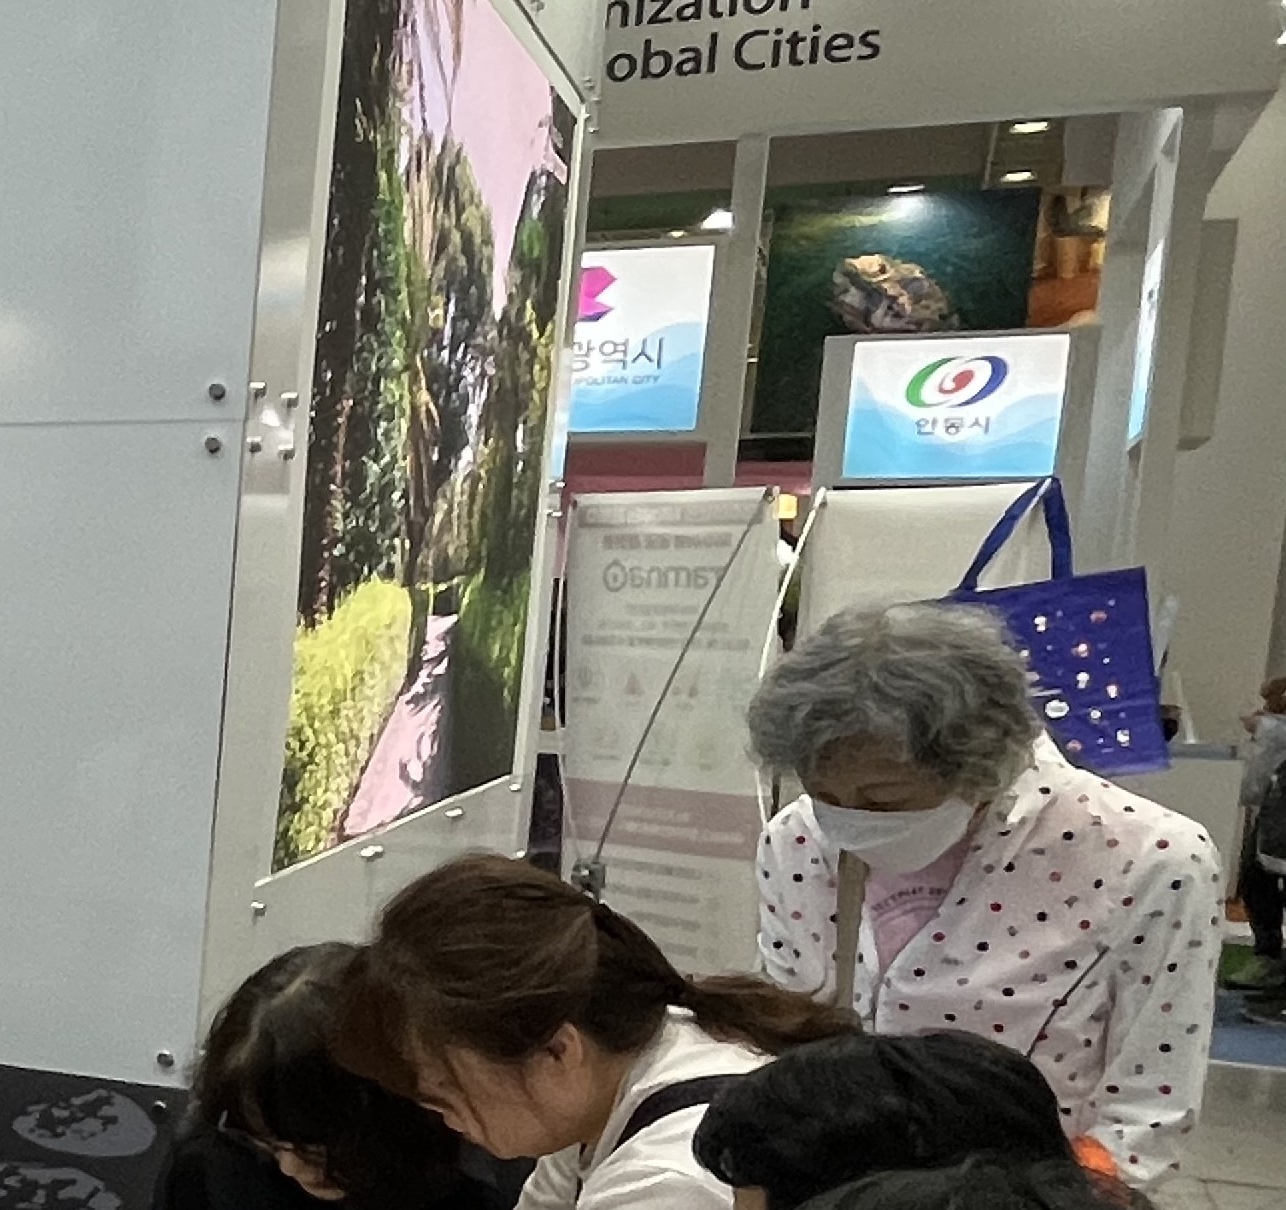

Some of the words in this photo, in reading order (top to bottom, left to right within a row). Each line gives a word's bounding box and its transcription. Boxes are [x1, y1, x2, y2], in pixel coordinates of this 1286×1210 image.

[606, 31, 719, 82] obal
[734, 24, 880, 71] Cities
[914, 416, 991, 436] 안동시
